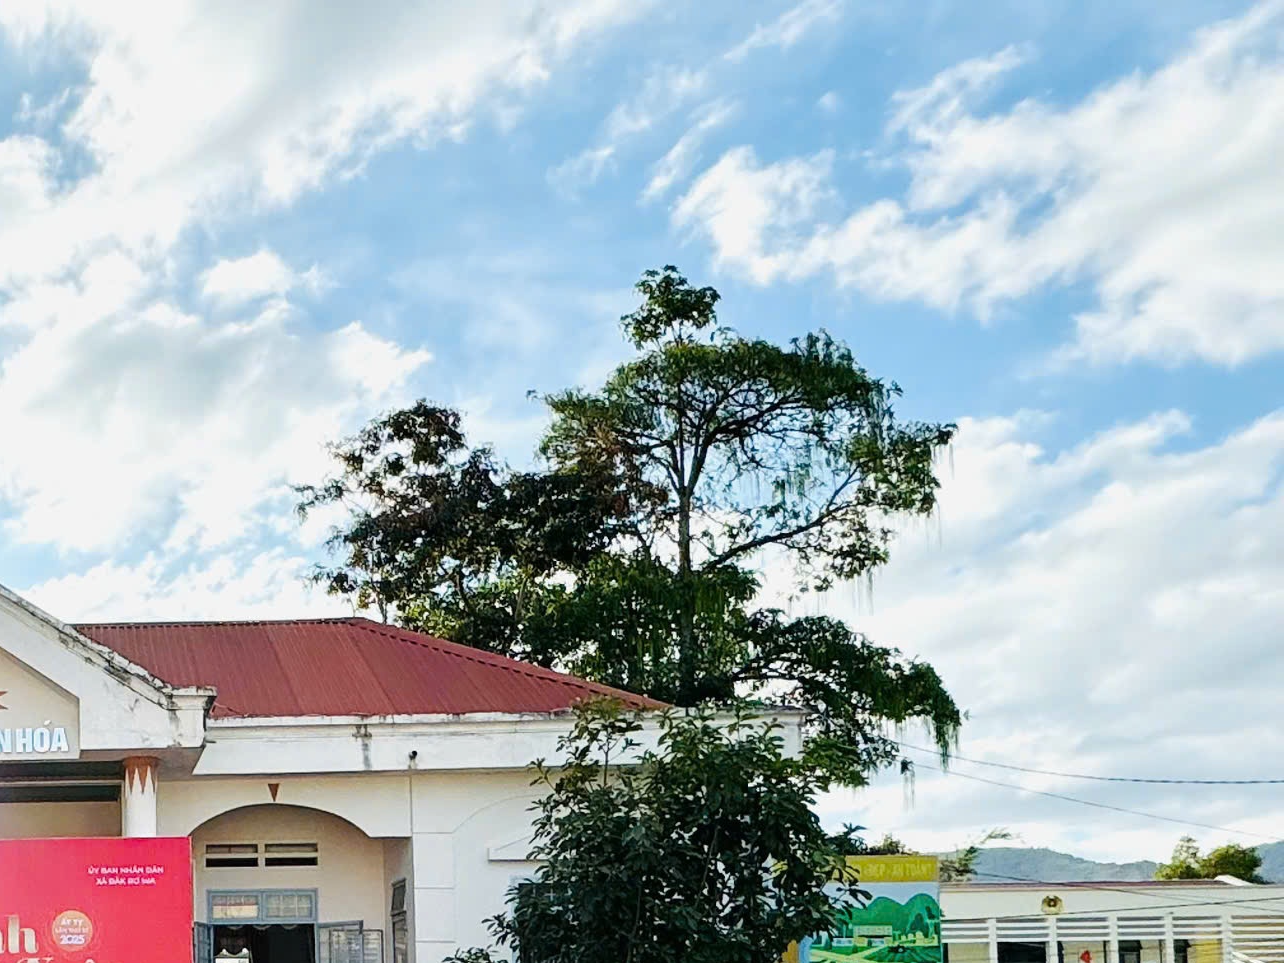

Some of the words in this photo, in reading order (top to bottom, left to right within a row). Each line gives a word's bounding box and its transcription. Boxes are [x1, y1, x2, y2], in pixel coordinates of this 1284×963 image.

[16, 719, 69, 753] HÓA
[101, 866, 118, 874] BAN
[59, 934, 85, 945] 2025
